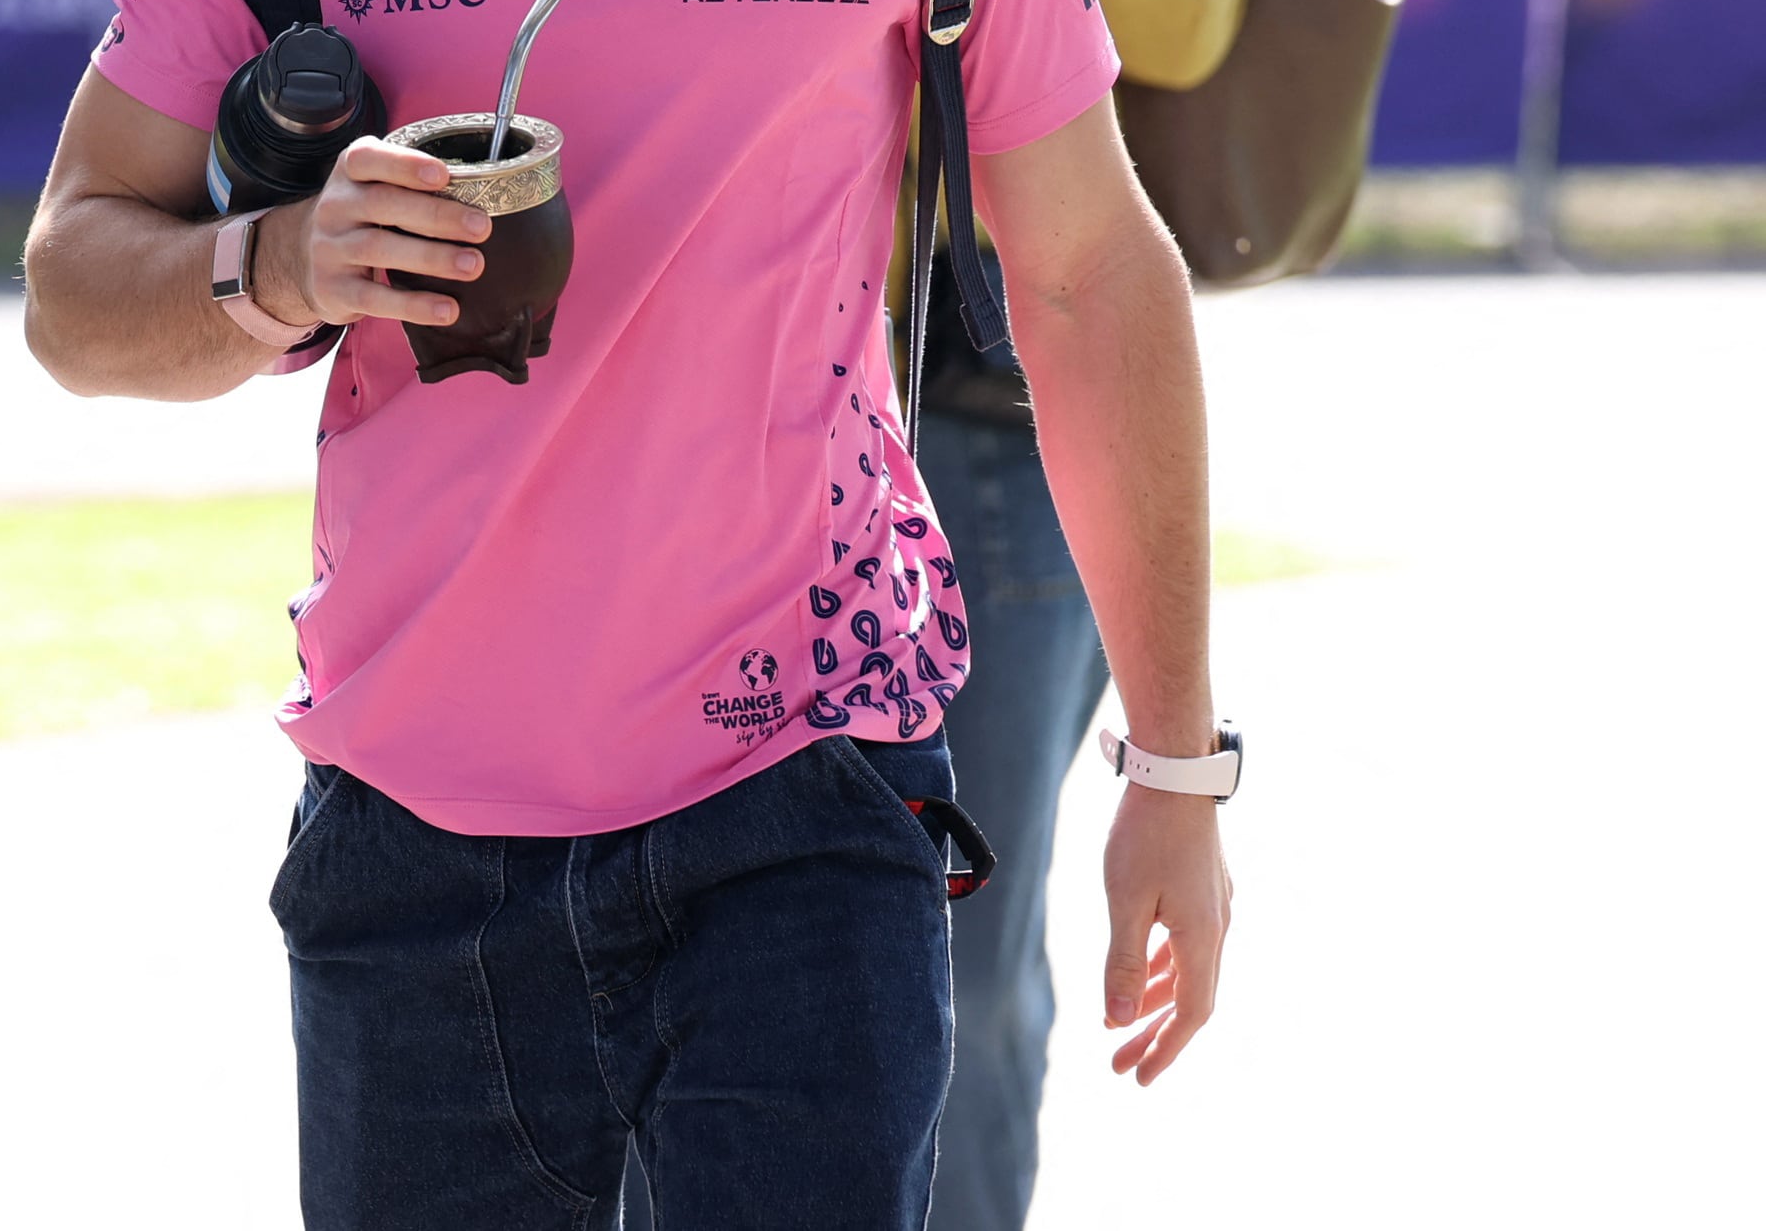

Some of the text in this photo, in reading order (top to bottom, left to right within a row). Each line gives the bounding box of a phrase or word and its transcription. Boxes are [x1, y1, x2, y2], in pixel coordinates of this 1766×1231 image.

[703, 691, 783, 716] CHANGE
[704, 706, 785, 730] THE WORLD
[736, 730, 755, 747] sip
[777, 716, 795, 732] si
